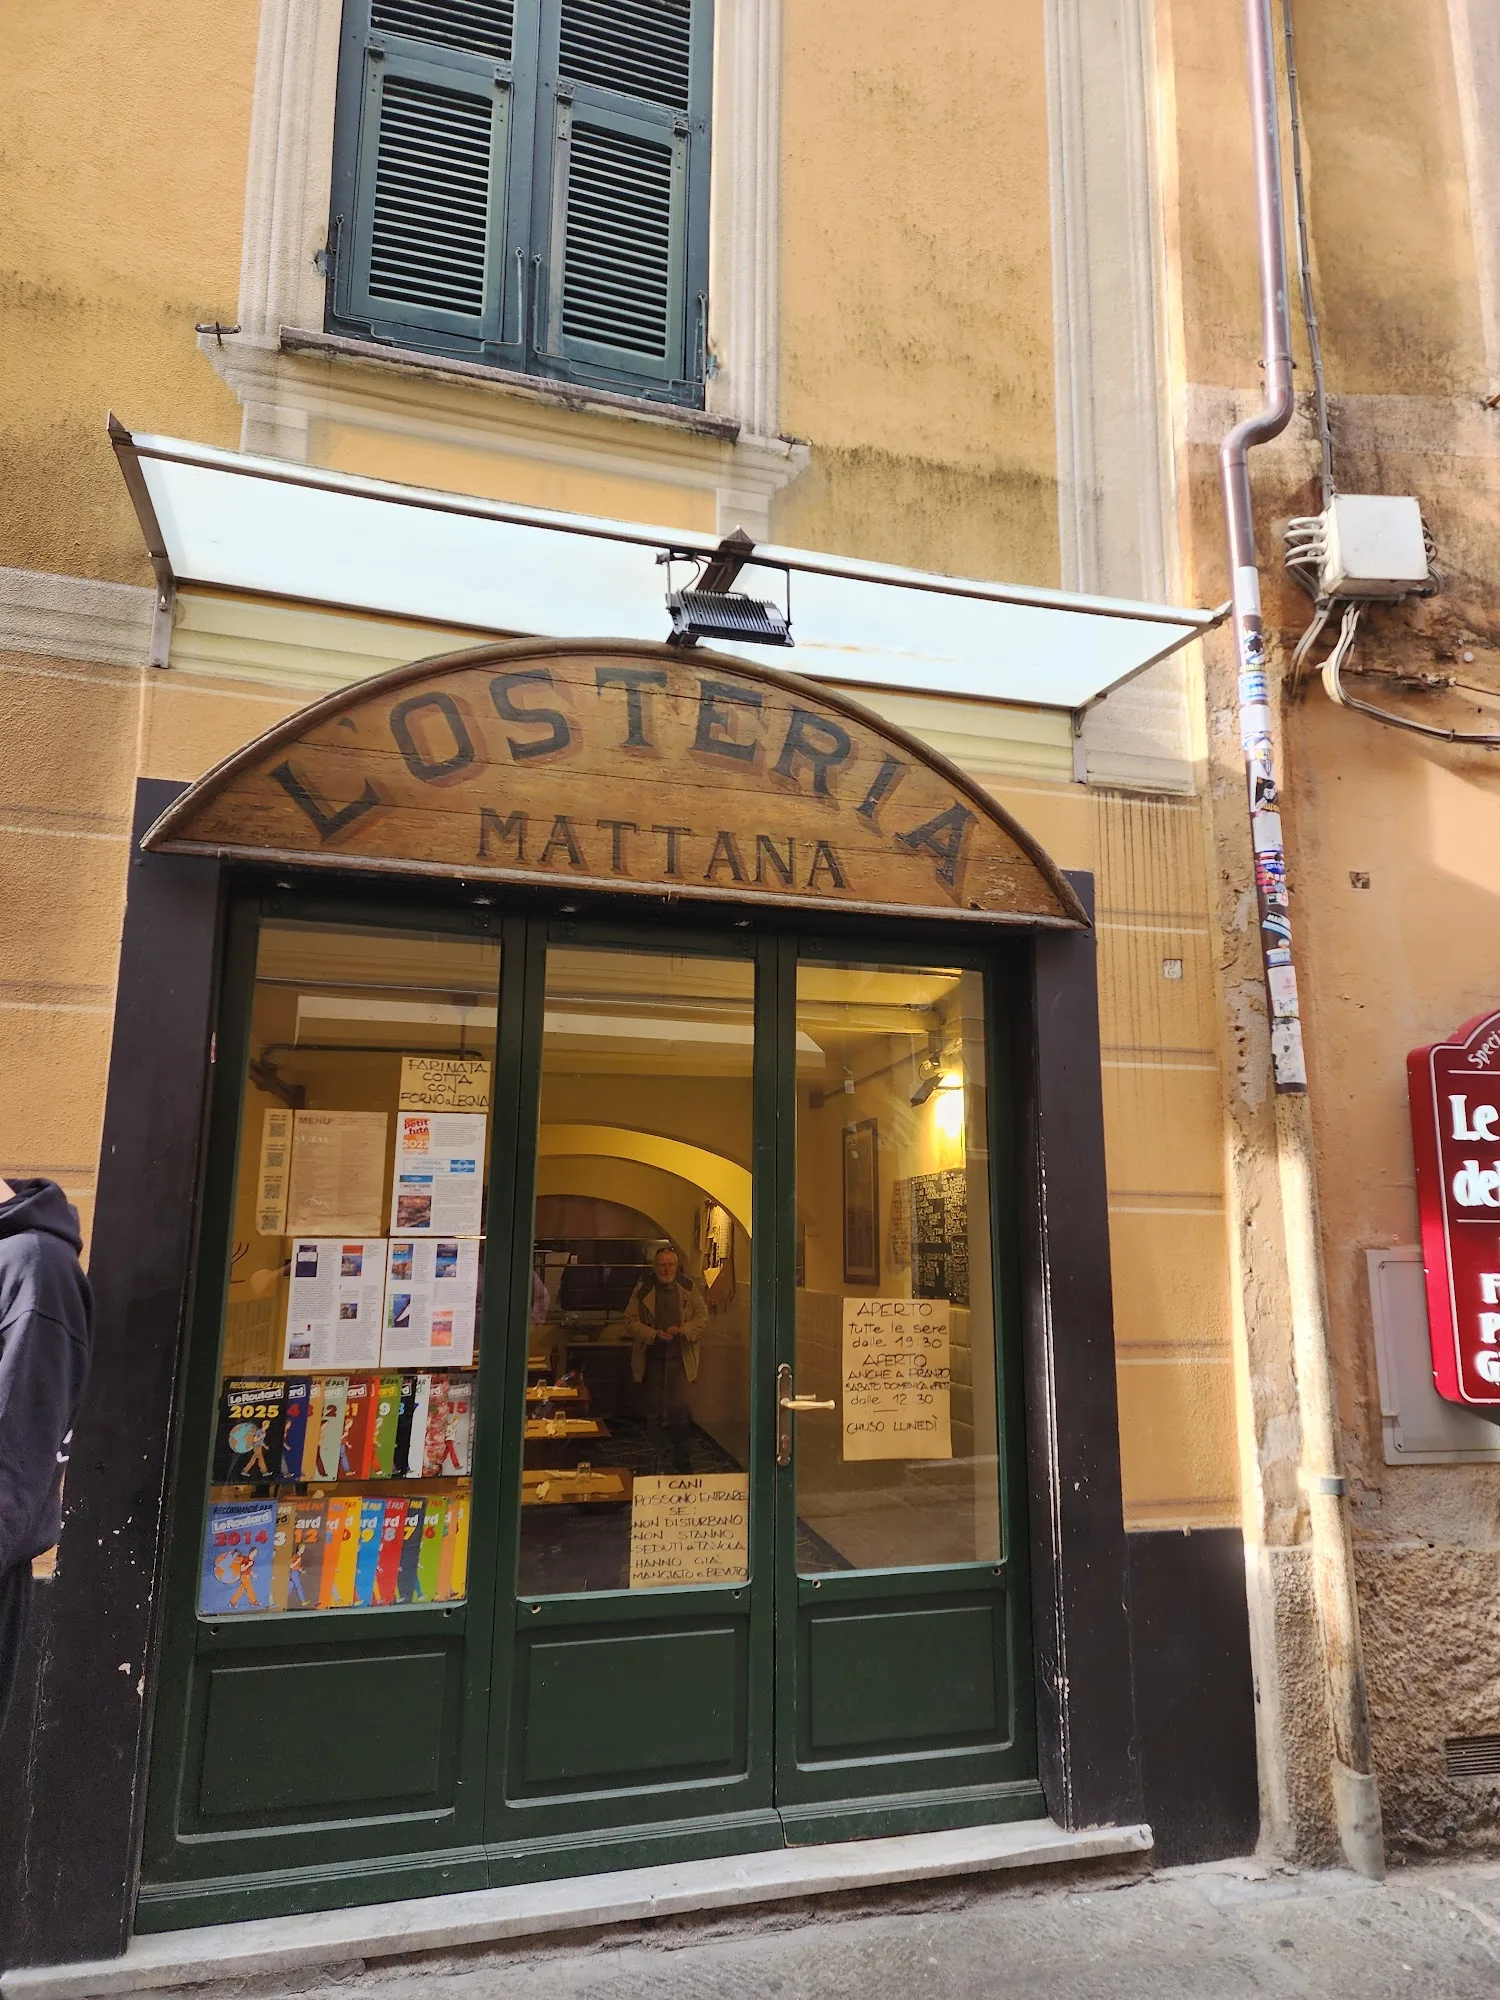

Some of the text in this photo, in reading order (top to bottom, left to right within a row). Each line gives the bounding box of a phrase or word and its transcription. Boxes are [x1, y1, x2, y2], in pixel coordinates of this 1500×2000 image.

[269, 666, 981, 890] L'OSTERIA
[476, 806, 847, 891] MATTANA
[408, 1059, 487, 1074] FARINATA
[423, 1072, 473, 1084] COTTA
[427, 1083, 457, 1093] CON
[400, 1092, 445, 1105] FORNO
[450, 1095, 488, 1107] LEGNA
[1448, 1094, 1500, 1141] Le
[404, 1119, 428, 1130] petit
[403, 1139, 429, 1149] 2023
[857, 1302, 933, 1317] APERTO
[891, 1322, 905, 1333] le
[913, 1324, 947, 1335] sere
[852, 1336, 887, 1348] dalle
[862, 1353, 928, 1368] APERTO
[848, 1367, 950, 1380] ANCHE A PRANZO
[850, 1394, 881, 1405] dalle
[228, 1405, 279, 1418] 2025
[657, 1478, 702, 1490] I CANI
[634, 1490, 747, 1507] POSSONO ENTRARE
[665, 1514, 743, 1528] DISTURBANO
[215, 1530, 268, 1547] 2014
[678, 1529, 734, 1540] STANNO
[635, 1542, 682, 1554] SEDUTI
[695, 1541, 746, 1551] TAVOLA
[635, 1558, 682, 1569] HANNO
[632, 1570, 694, 1580] MANGIATO
[706, 1567, 748, 1578] BEVUTO
